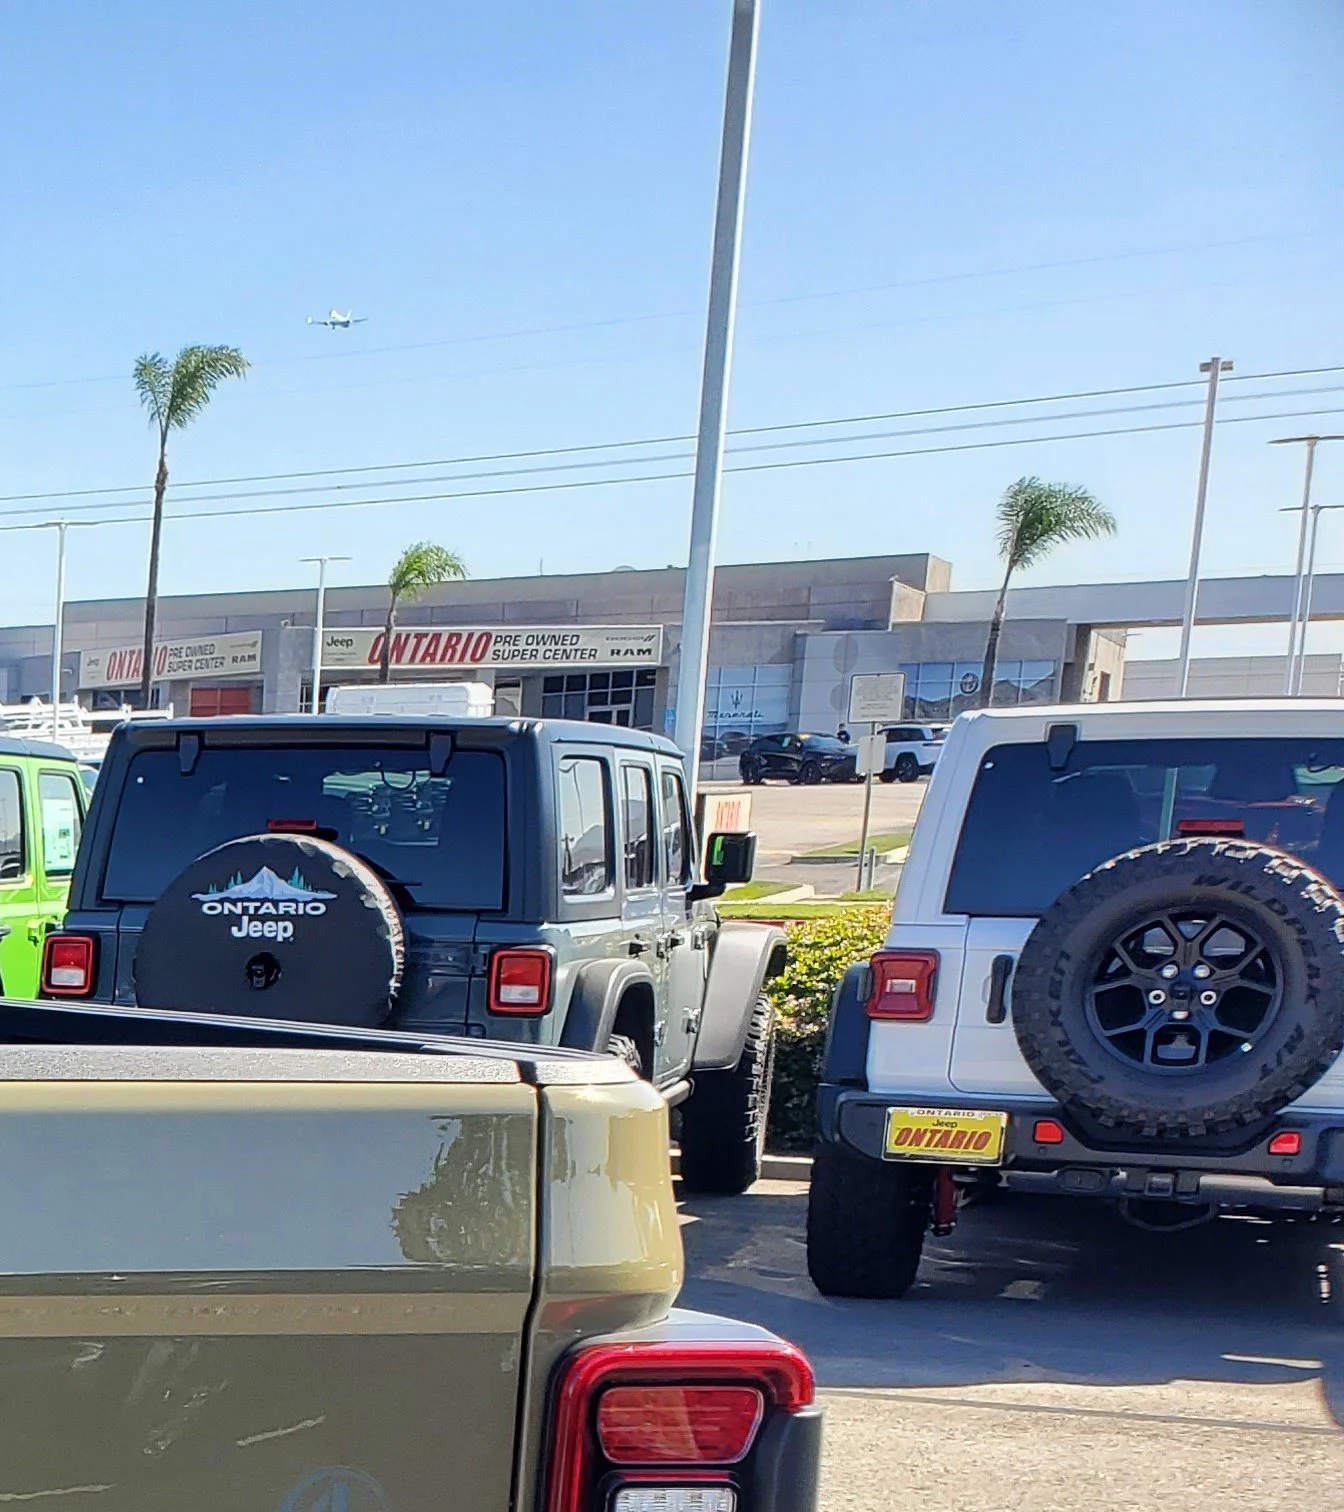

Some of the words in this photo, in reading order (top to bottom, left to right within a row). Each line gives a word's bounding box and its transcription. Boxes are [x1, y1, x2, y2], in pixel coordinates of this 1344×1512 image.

[326, 636, 353, 649] Jeep
[493, 634, 521, 647] PRE
[525, 634, 580, 646] OWNED
[168, 646, 185, 660] PRE
[185, 643, 216, 658] OWNED
[368, 631, 493, 665] ONTARIO
[491, 649, 538, 661] SUPER
[542, 648, 598, 660] CENTER
[610, 648, 652, 657] RAM
[106, 646, 168, 681] ONTAIO
[167, 659, 194, 673] SUPER
[194, 656, 226, 671] CENTER
[231, 653, 257, 665] RAM
[202, 902, 327, 915] ONTARIO
[231, 916, 294, 942] Jeep
[917, 1109, 975, 1117] ONTARIO
[932, 1119, 958, 1128] Jeep
[894, 1127, 992, 1151] ONTARIO
